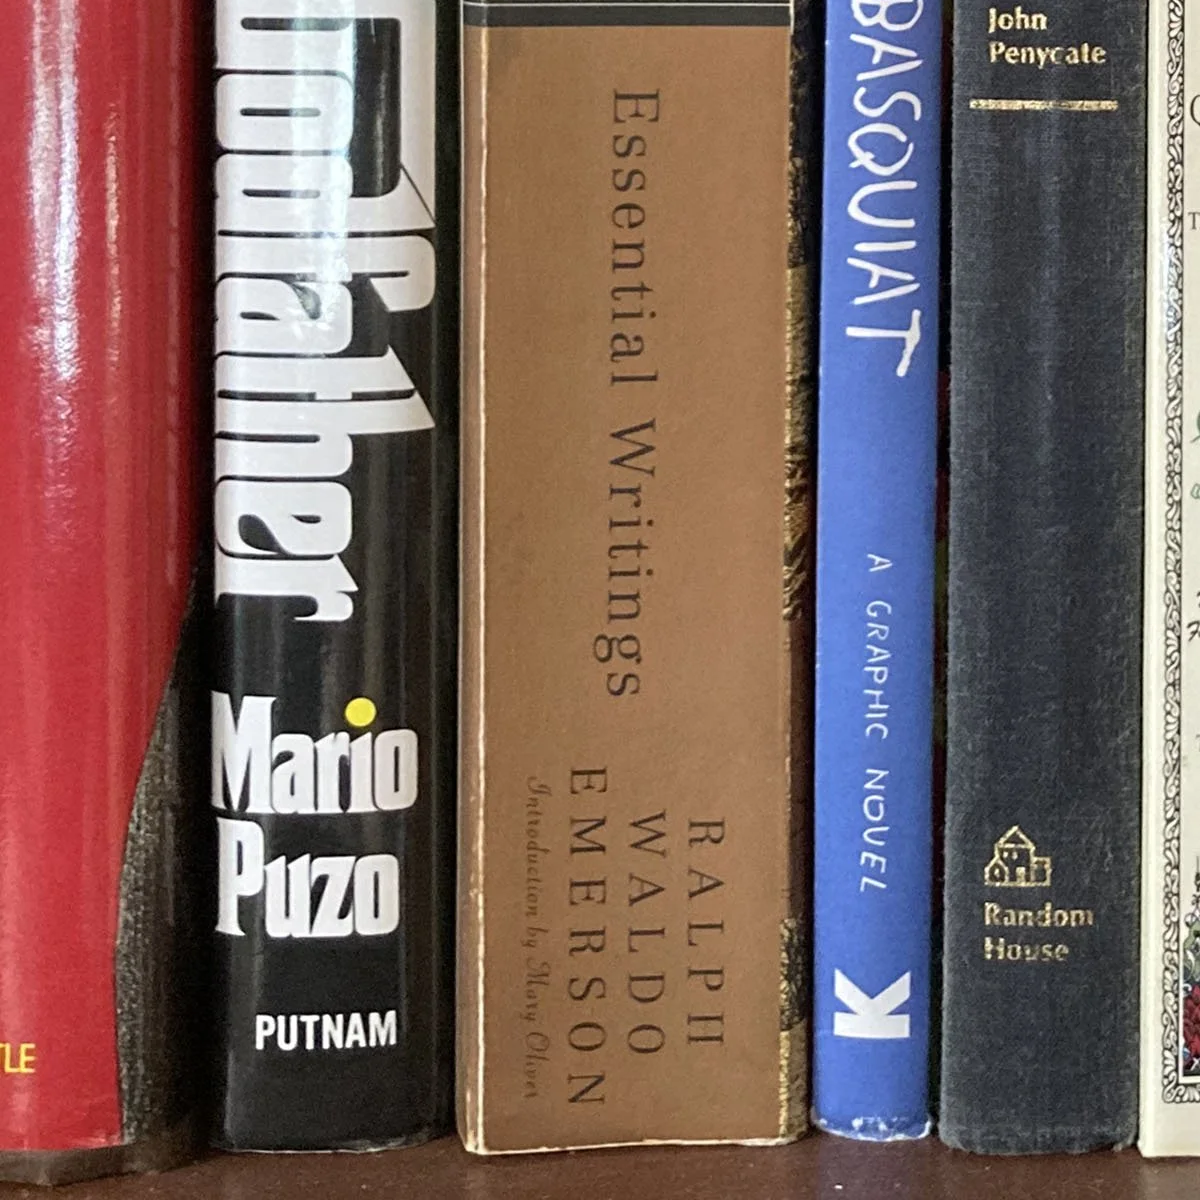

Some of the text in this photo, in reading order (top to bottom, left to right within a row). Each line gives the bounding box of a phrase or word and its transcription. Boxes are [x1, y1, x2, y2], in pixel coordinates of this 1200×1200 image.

[988, 6, 1047, 33] John
[988, 41, 1107, 69] Penycate
[593, 89, 660, 696] Essential Writings
[211, 691, 418, 814] Mario
[860, 553, 893, 893] A GRAPHIC NOVEL
[215, 816, 399, 938] Puzo
[522, 776, 552, 1099] Introduction by Mary Oliver
[567, 767, 608, 1104] EMERSON
[627, 809, 666, 1054] WALDO
[687, 818, 725, 1045] RALPH
[984, 902, 1094, 927] Random
[984, 936, 1070, 961] House
[255, 1010, 397, 1051] PUTNAM
